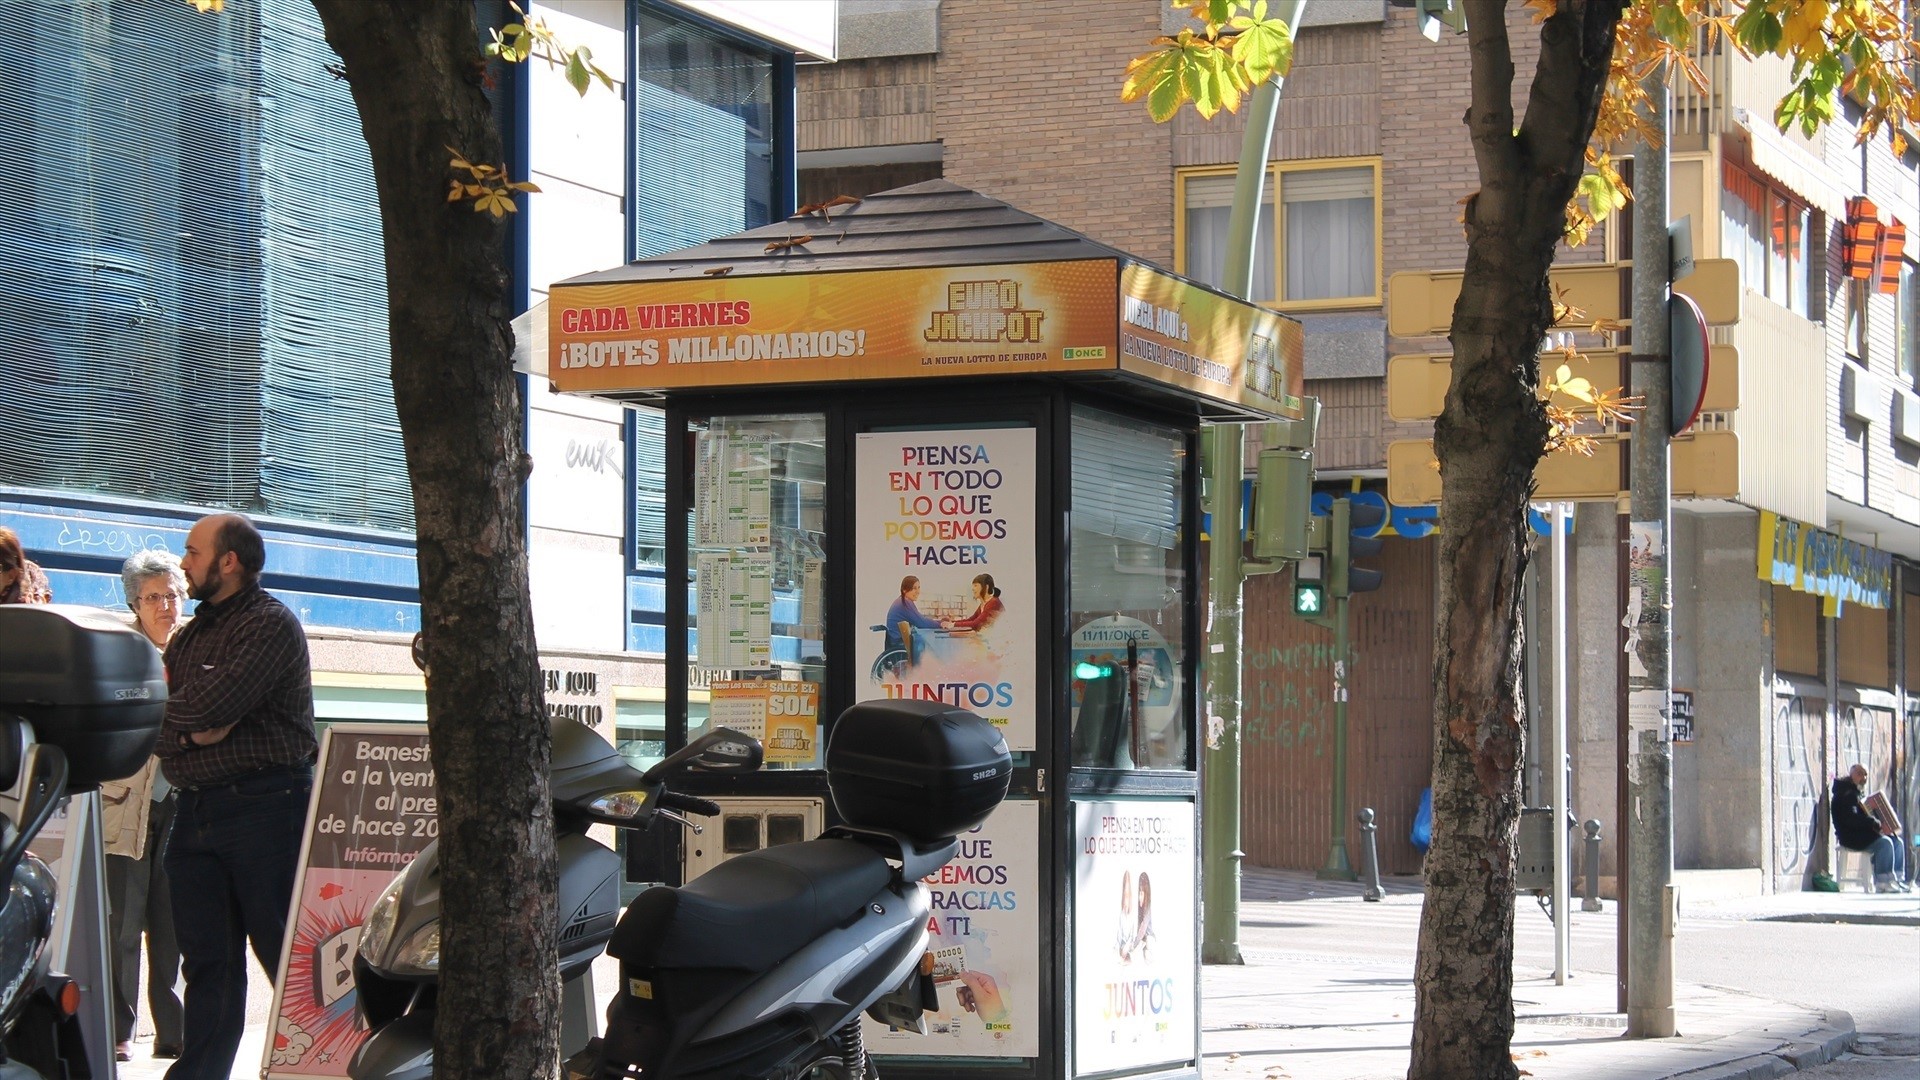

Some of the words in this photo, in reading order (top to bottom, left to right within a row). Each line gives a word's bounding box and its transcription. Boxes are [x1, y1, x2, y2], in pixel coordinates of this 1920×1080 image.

[948, 279, 1020, 311] EURO
[561, 306, 630, 333] CADA
[637, 300, 751, 330] VIERNES
[924, 310, 1044, 343] JACKPOT
[1124, 295, 1154, 330] JUEGA
[1156, 306, 1180, 339] AQUÍ
[1182, 321, 1188, 343] a
[560, 338, 660, 369] ¡BOTES
[667, 329, 867, 364] MILLONARIOS!
[921, 357, 933, 366] LA
[935, 355, 964, 365] NUEVA
[967, 354, 996, 364] LOTTO
[998, 353, 1010, 362] DE
[1013, 352, 1047, 361] EUROPA
[1075, 349, 1103, 357] ONCE
[1124, 333, 1134, 356] LA
[1136, 336, 1162, 365] NUEVA
[1164, 346, 1188, 373] LOTTO
[1190, 355, 1201, 377] DE
[1202, 358, 1232, 386] EUROPA
[902, 444, 990, 466] PIENSA
[889, 471, 922, 491] EN
[928, 469, 1003, 491] TODO
[899, 495, 932, 516] LO
[938, 494, 992, 516] QUE
[884, 519, 1007, 542] PODEMOS
[903, 544, 988, 566] HACER
[1082, 630, 1150, 641] 11/11/ONCE
[769, 682, 798, 693] SALE
[801, 683, 815, 693] EL
[881, 682, 1013, 708] JUNTOS
[769, 694, 816, 716] SOL
[777, 729, 802, 739] EURO
[355, 741, 432, 762] Banest
[341, 769, 356, 784] a
[362, 764, 383, 785] la
[389, 769, 437, 787] vent
[972, 768, 997, 780] SH29
[375, 791, 397, 811] al
[401, 796, 438, 816] pre
[318, 813, 346, 834] de
[351, 814, 406, 836] hace
[1102, 817, 1132, 834] PIENSA
[1133, 817, 1144, 834] EN
[344, 847, 420, 864] Infórmat
[954, 840, 992, 859] UE
[1084, 837, 1096, 854] LO
[1098, 837, 1117, 854] QUE
[1120, 837, 1161, 854] PODEMOS
[922, 865, 1007, 885] CEMOS
[931, 891, 1016, 911] RACIAS
[927, 917, 941, 936] A
[946, 916, 971, 936] TI
[937, 947, 962, 958] 00000
[1103, 977, 1173, 1020] JUNTOS
